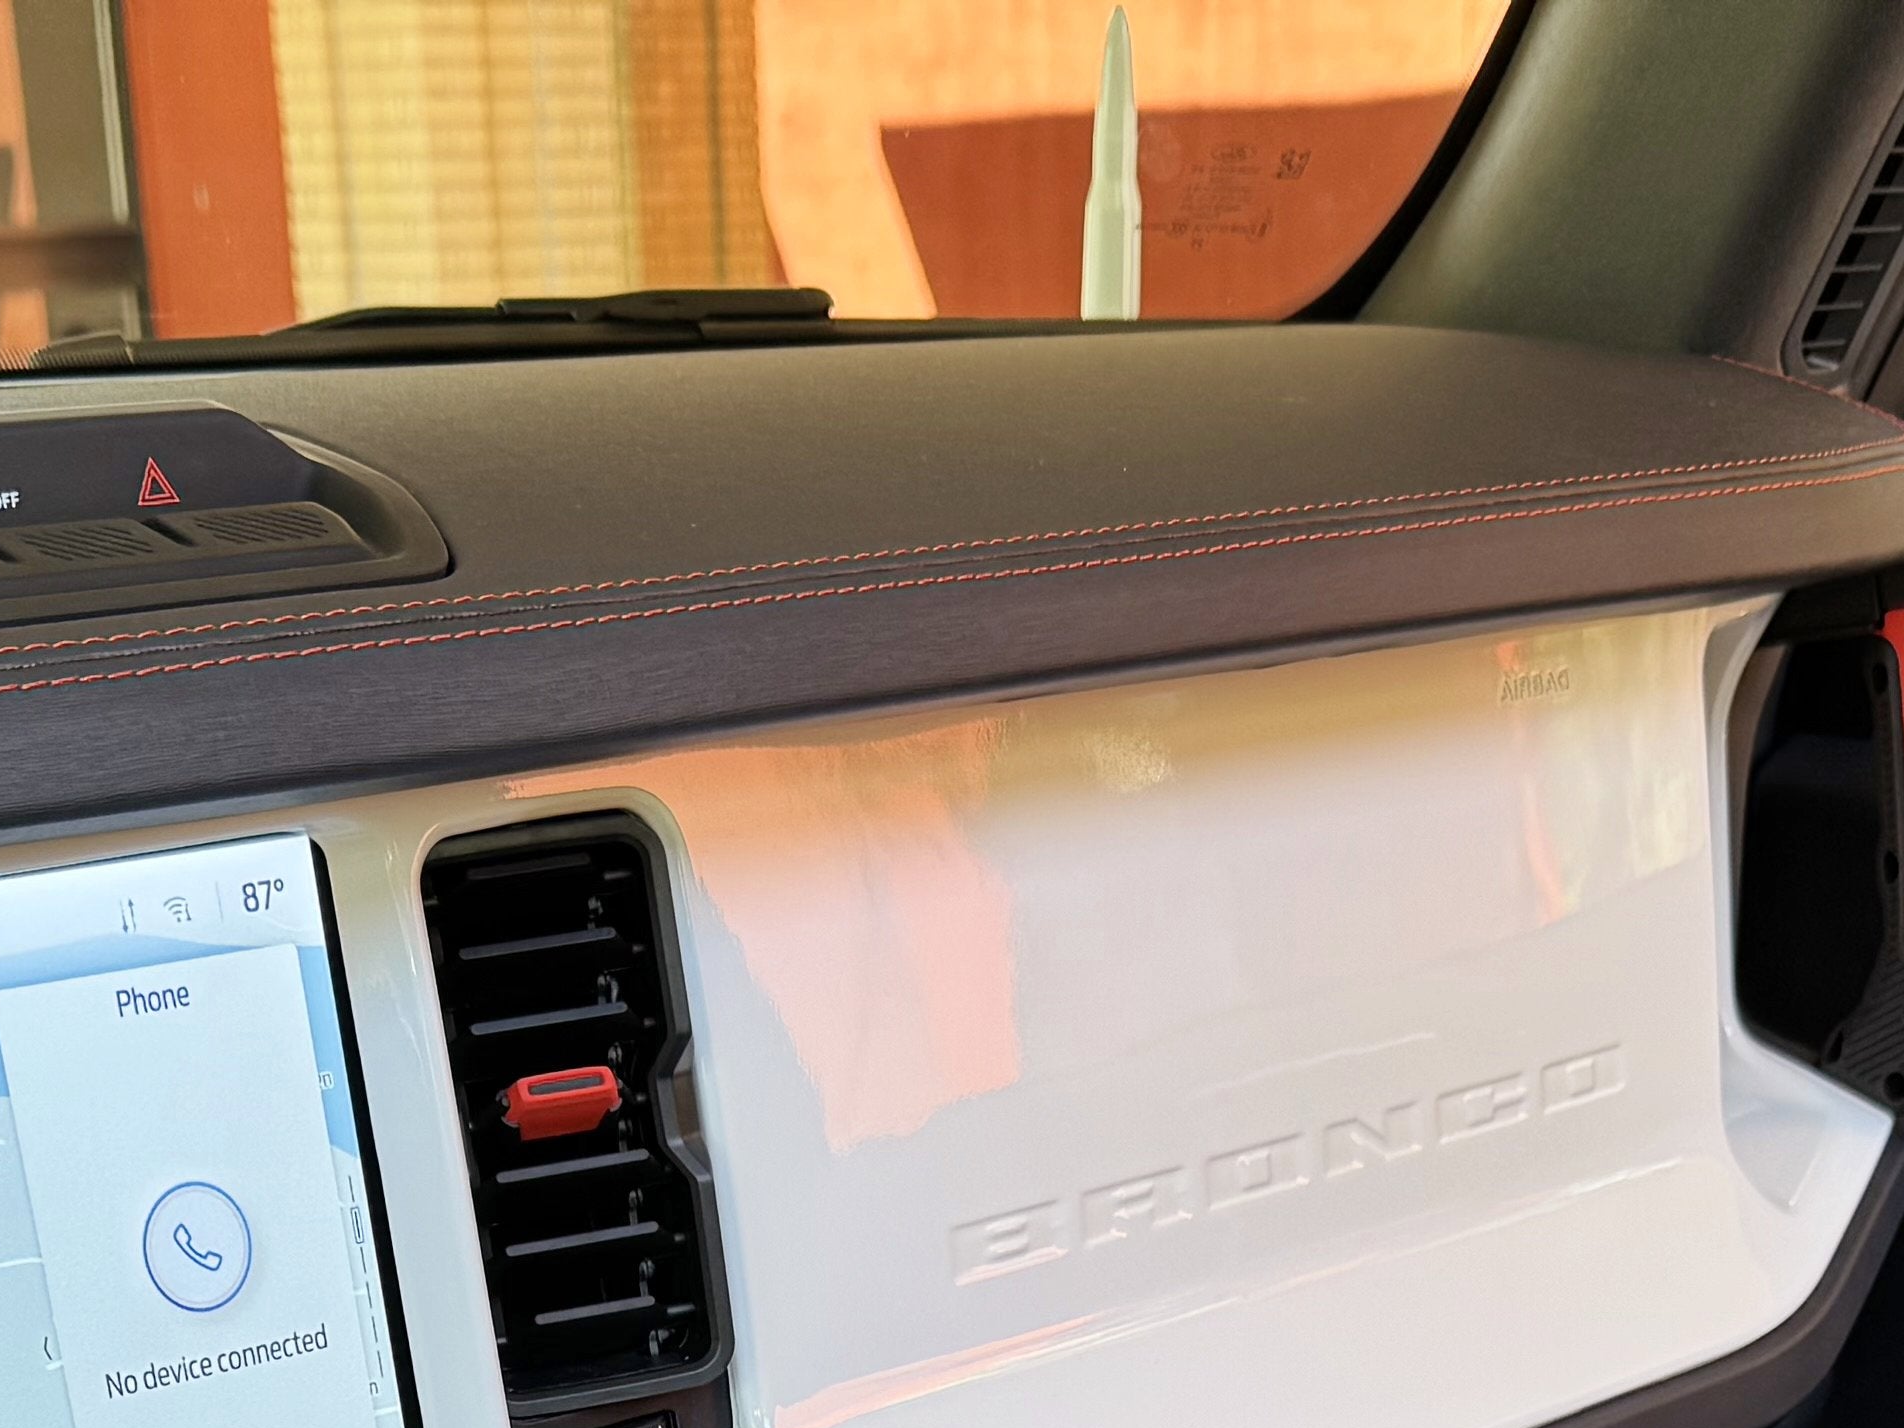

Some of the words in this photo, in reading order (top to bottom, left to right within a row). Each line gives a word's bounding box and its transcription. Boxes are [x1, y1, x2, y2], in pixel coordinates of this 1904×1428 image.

[115, 982, 191, 1018] Phone
[948, 1042, 1628, 1288] BRONCO
[105, 1371, 137, 1401] No
[142, 1355, 214, 1393] device
[217, 1323, 330, 1380] connected
